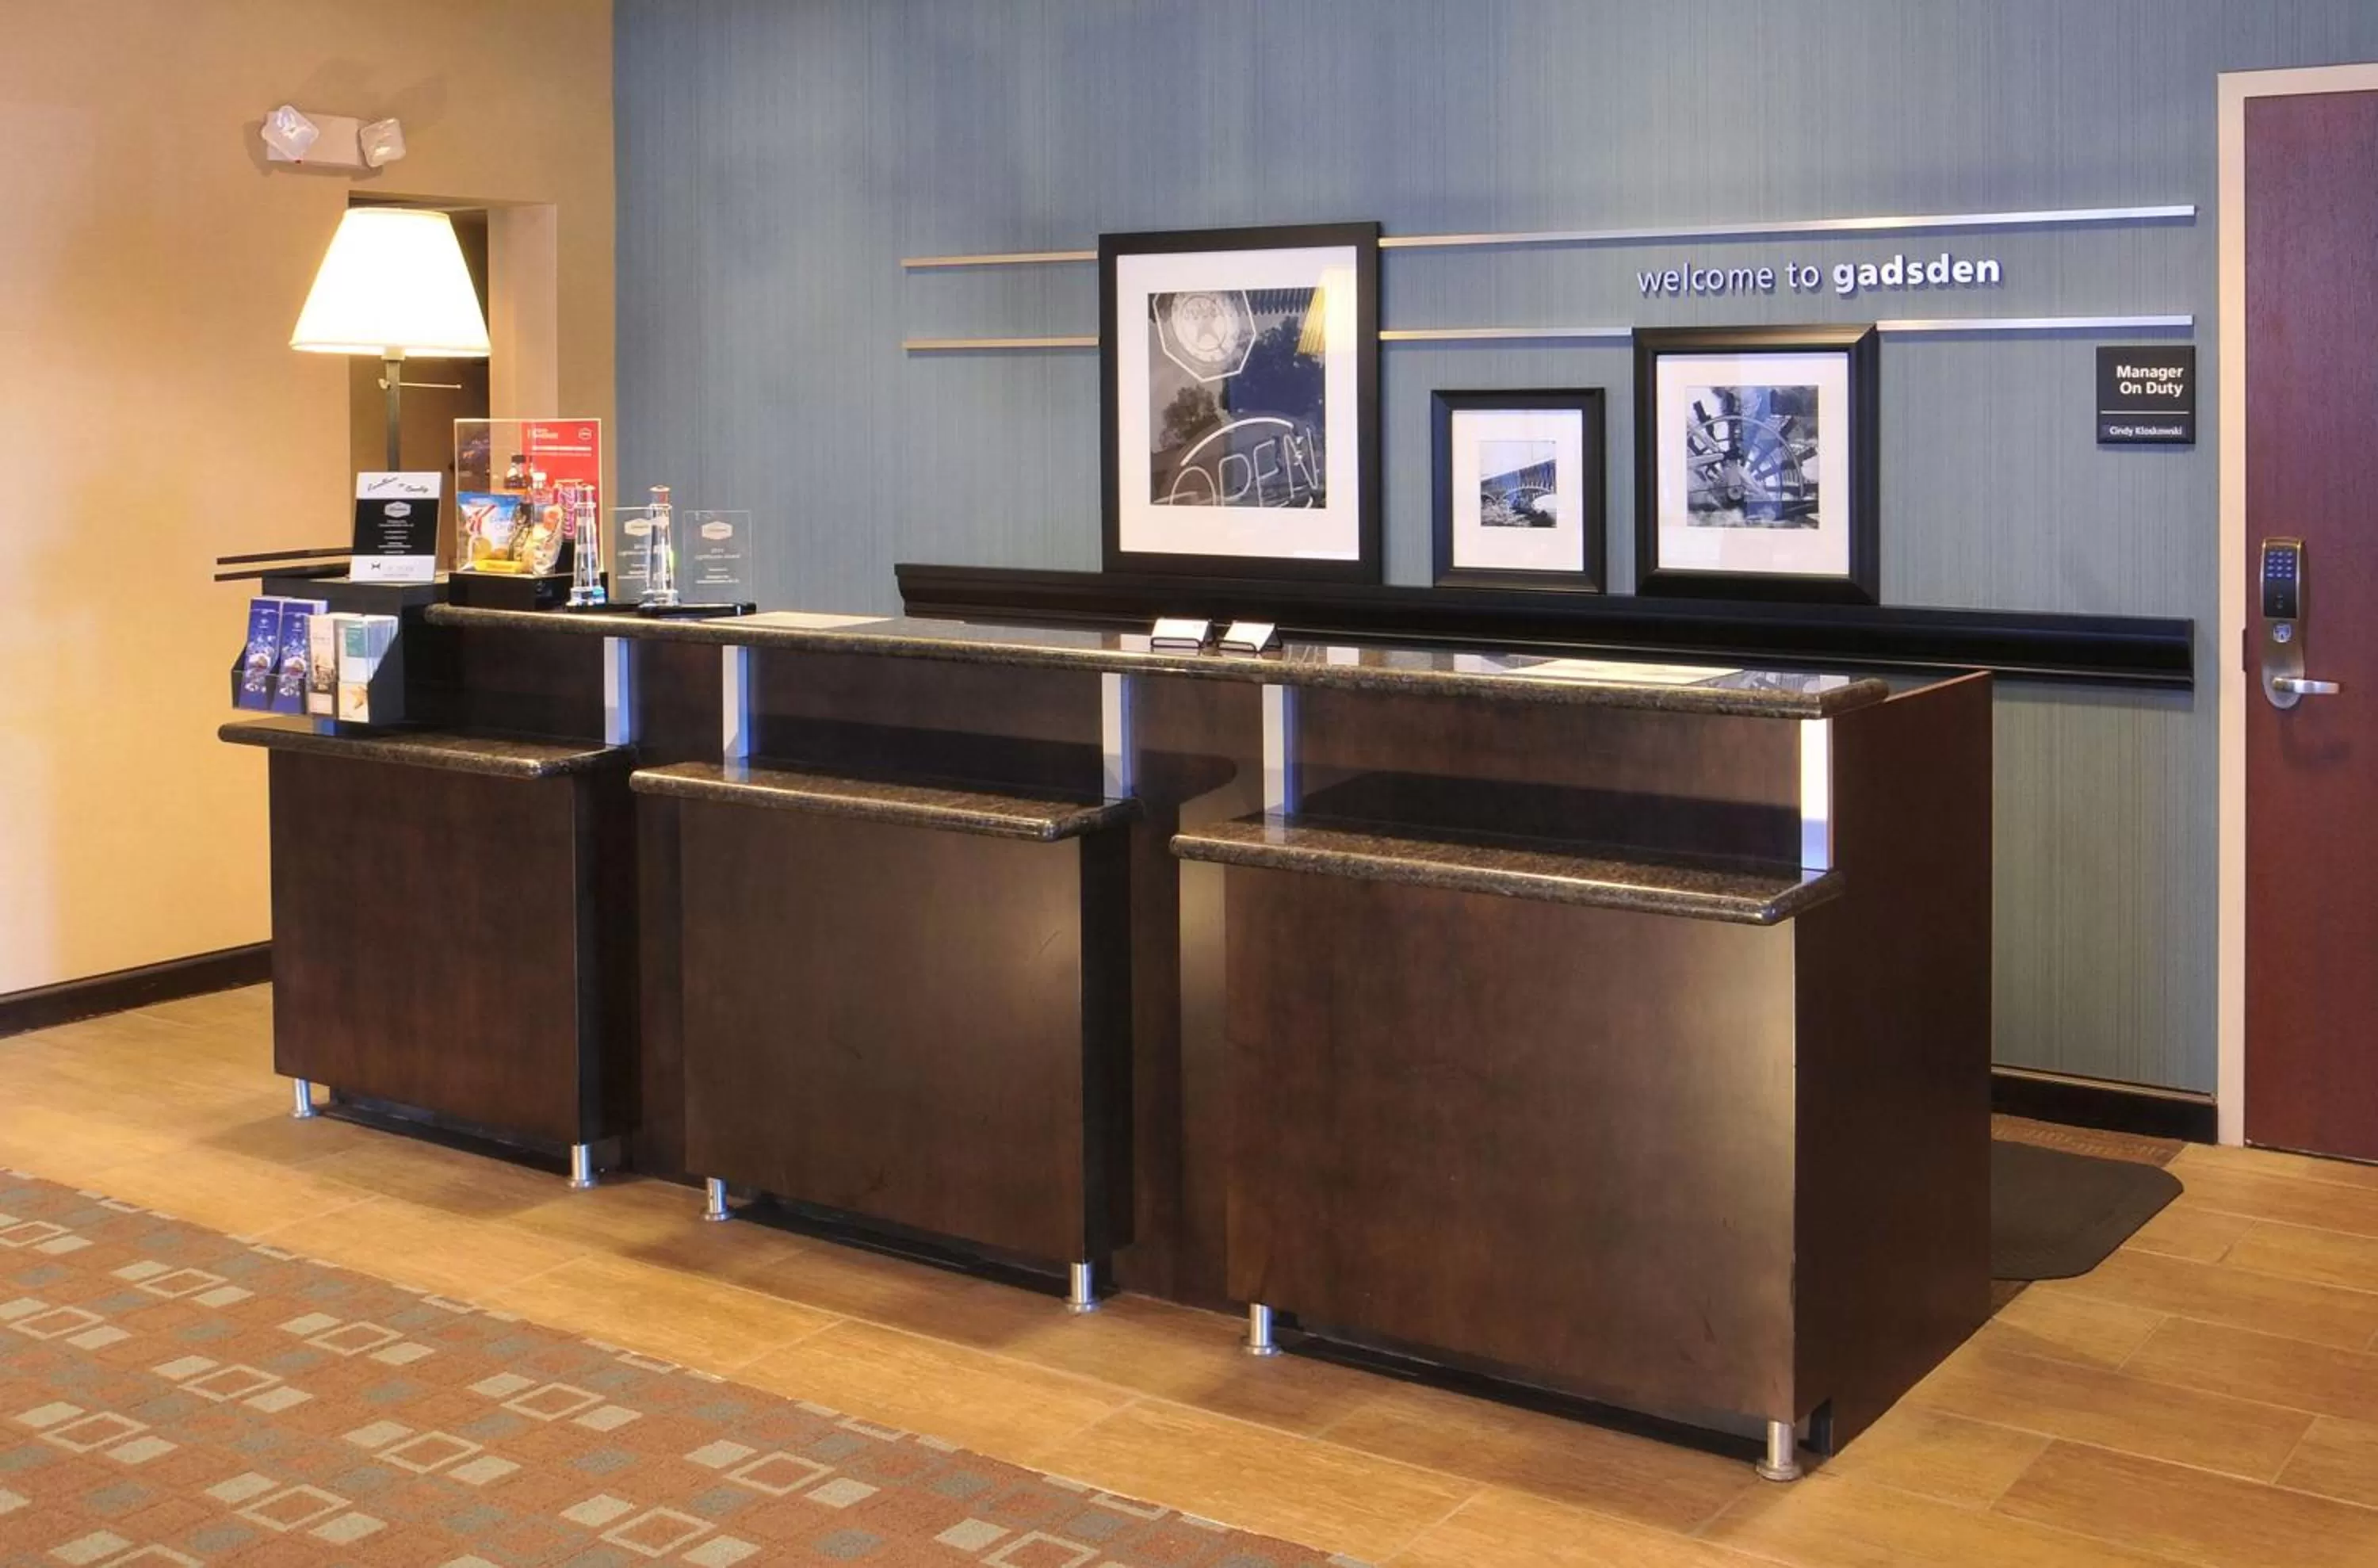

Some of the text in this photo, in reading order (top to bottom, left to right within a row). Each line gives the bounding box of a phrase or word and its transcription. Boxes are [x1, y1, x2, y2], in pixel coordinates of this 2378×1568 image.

[1637, 254, 2001, 294] welcome to gadsden
[2116, 365, 2184, 381] Manager
[2120, 381, 2183, 397] On Duty
